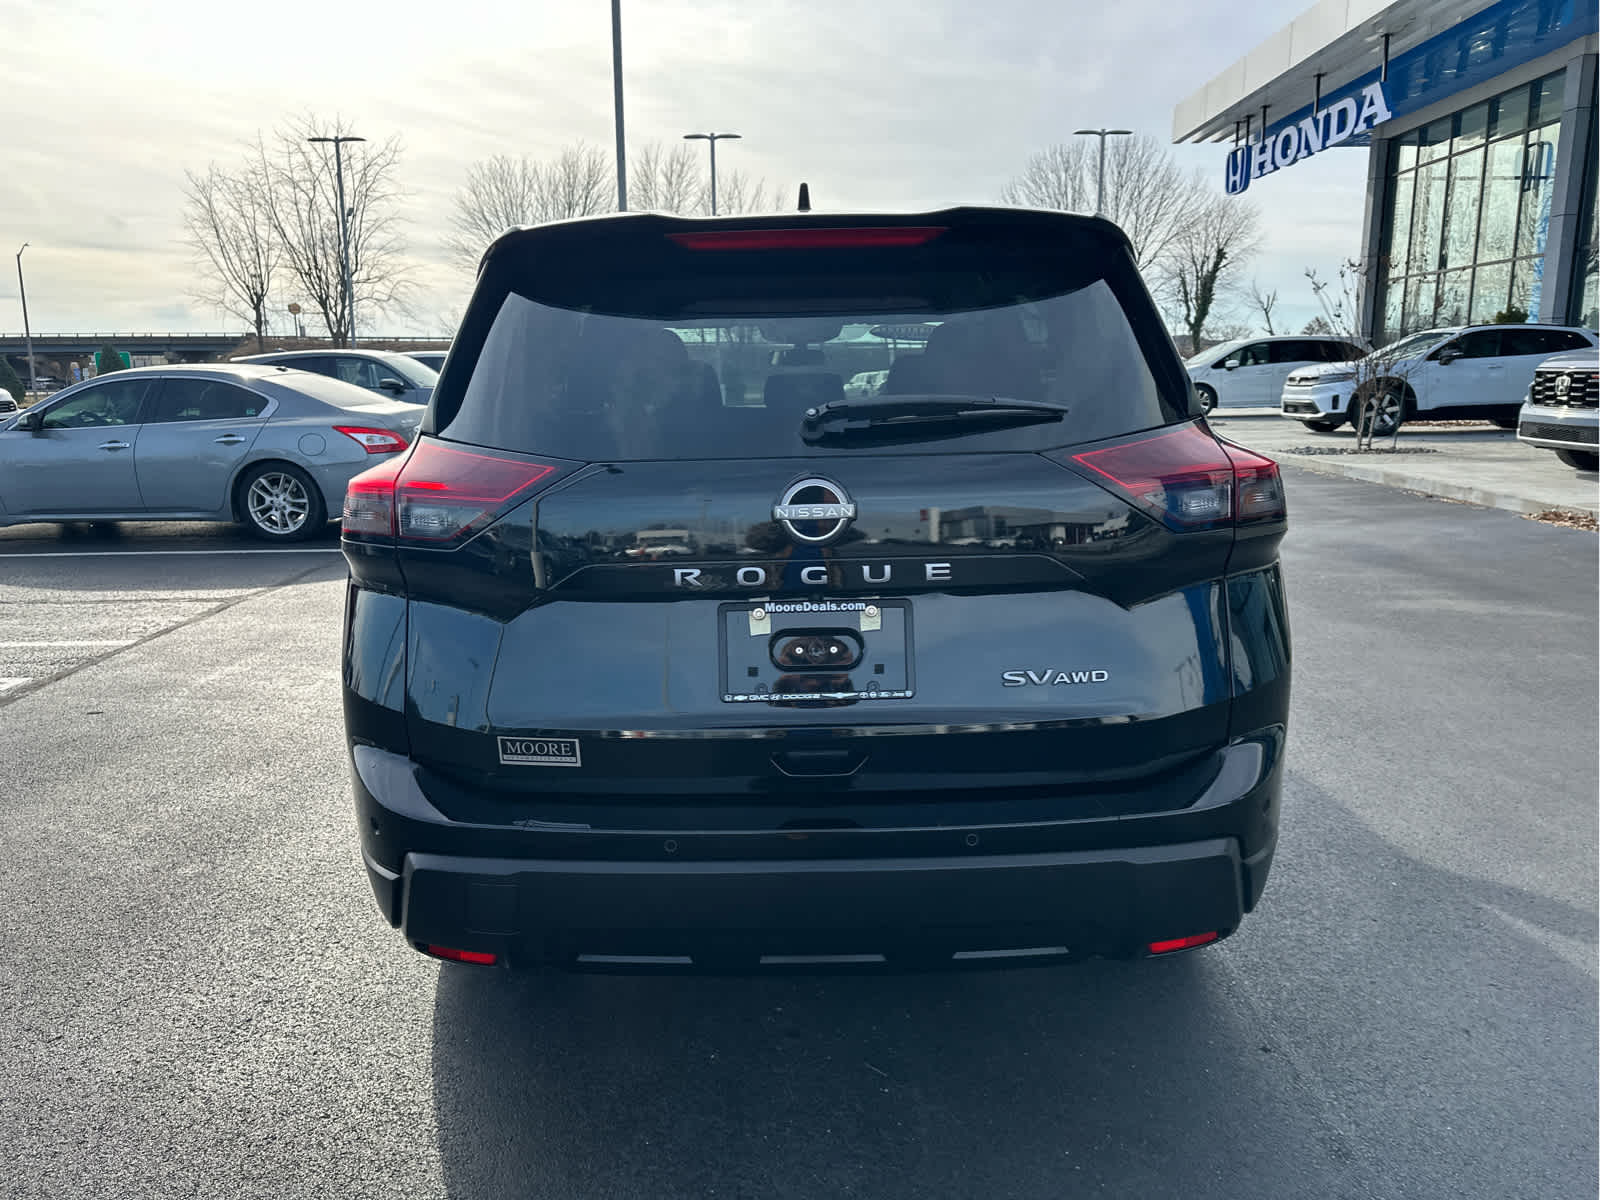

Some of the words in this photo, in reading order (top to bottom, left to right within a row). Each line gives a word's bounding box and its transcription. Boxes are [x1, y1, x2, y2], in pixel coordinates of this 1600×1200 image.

[1251, 81, 1392, 180] HONDA
[776, 506, 854, 518] NISSAN
[673, 563, 952, 586] ROGUE
[764, 602, 866, 613] MooreDeals.com
[505, 741, 572, 755] MOORE
